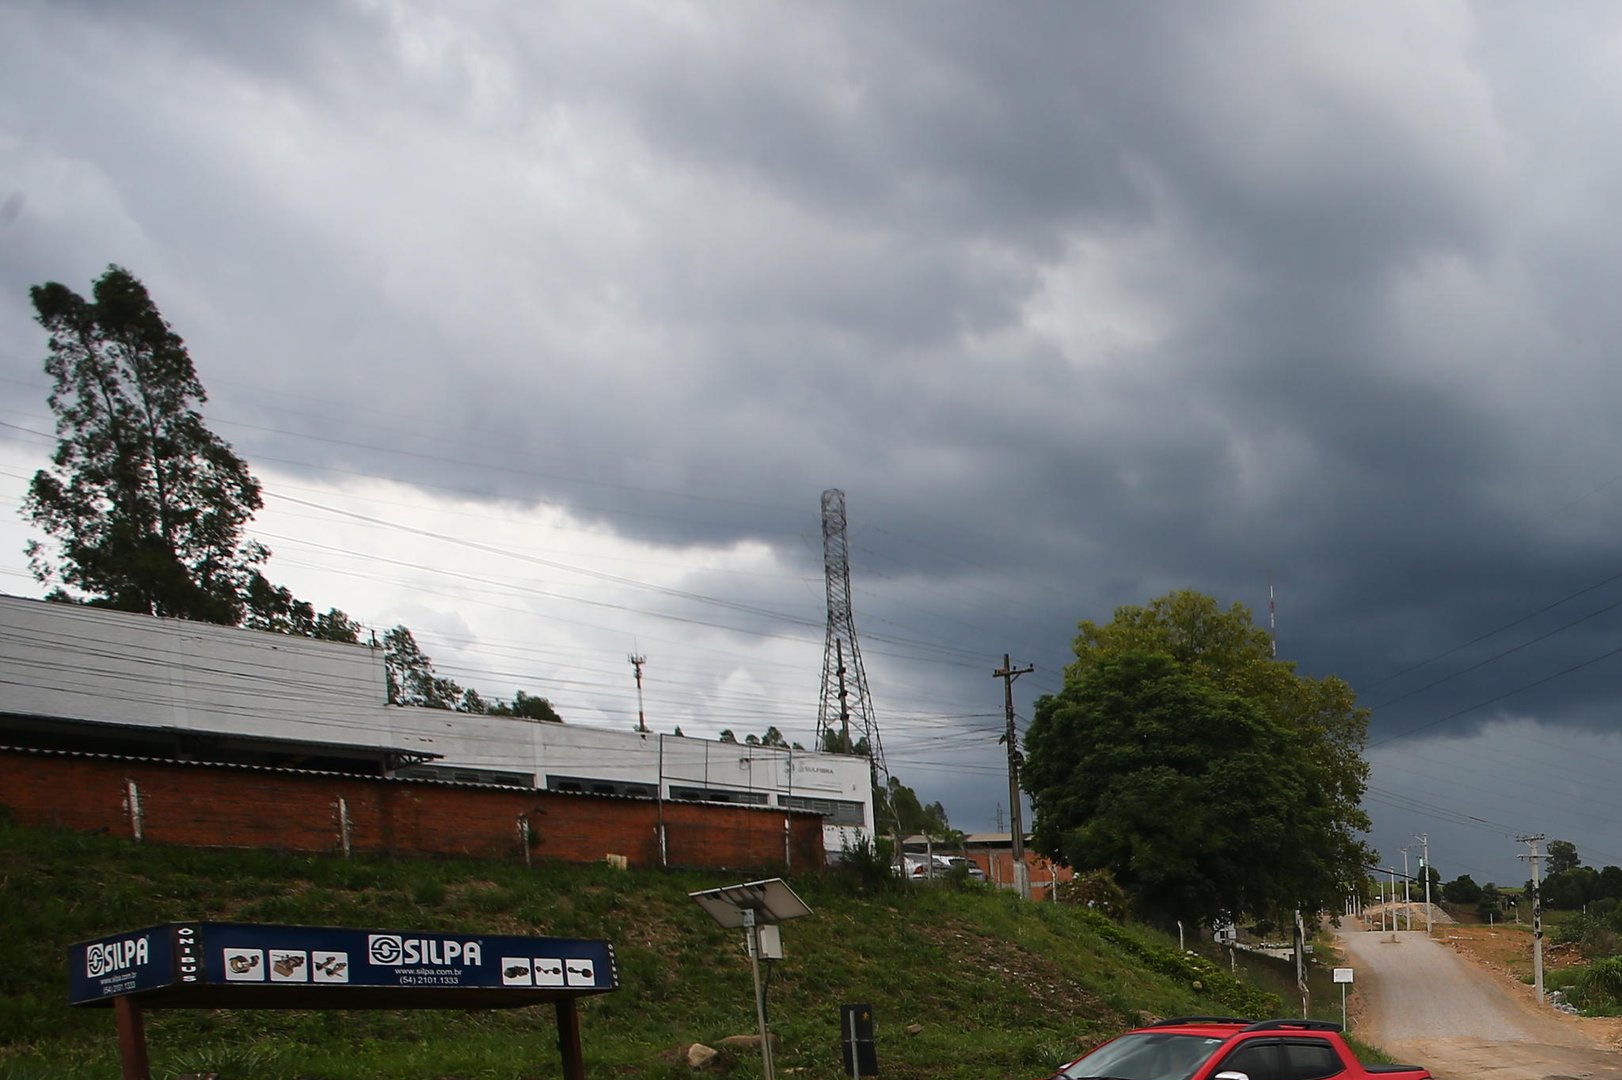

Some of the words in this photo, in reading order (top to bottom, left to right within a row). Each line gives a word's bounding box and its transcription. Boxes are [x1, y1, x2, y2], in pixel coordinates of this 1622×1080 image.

[104, 937, 149, 972] SILPA
[404, 940, 481, 966] SILPA
[395, 968, 462, 976] www.silpa.com.br
[400, 976, 416, 984] (54)
